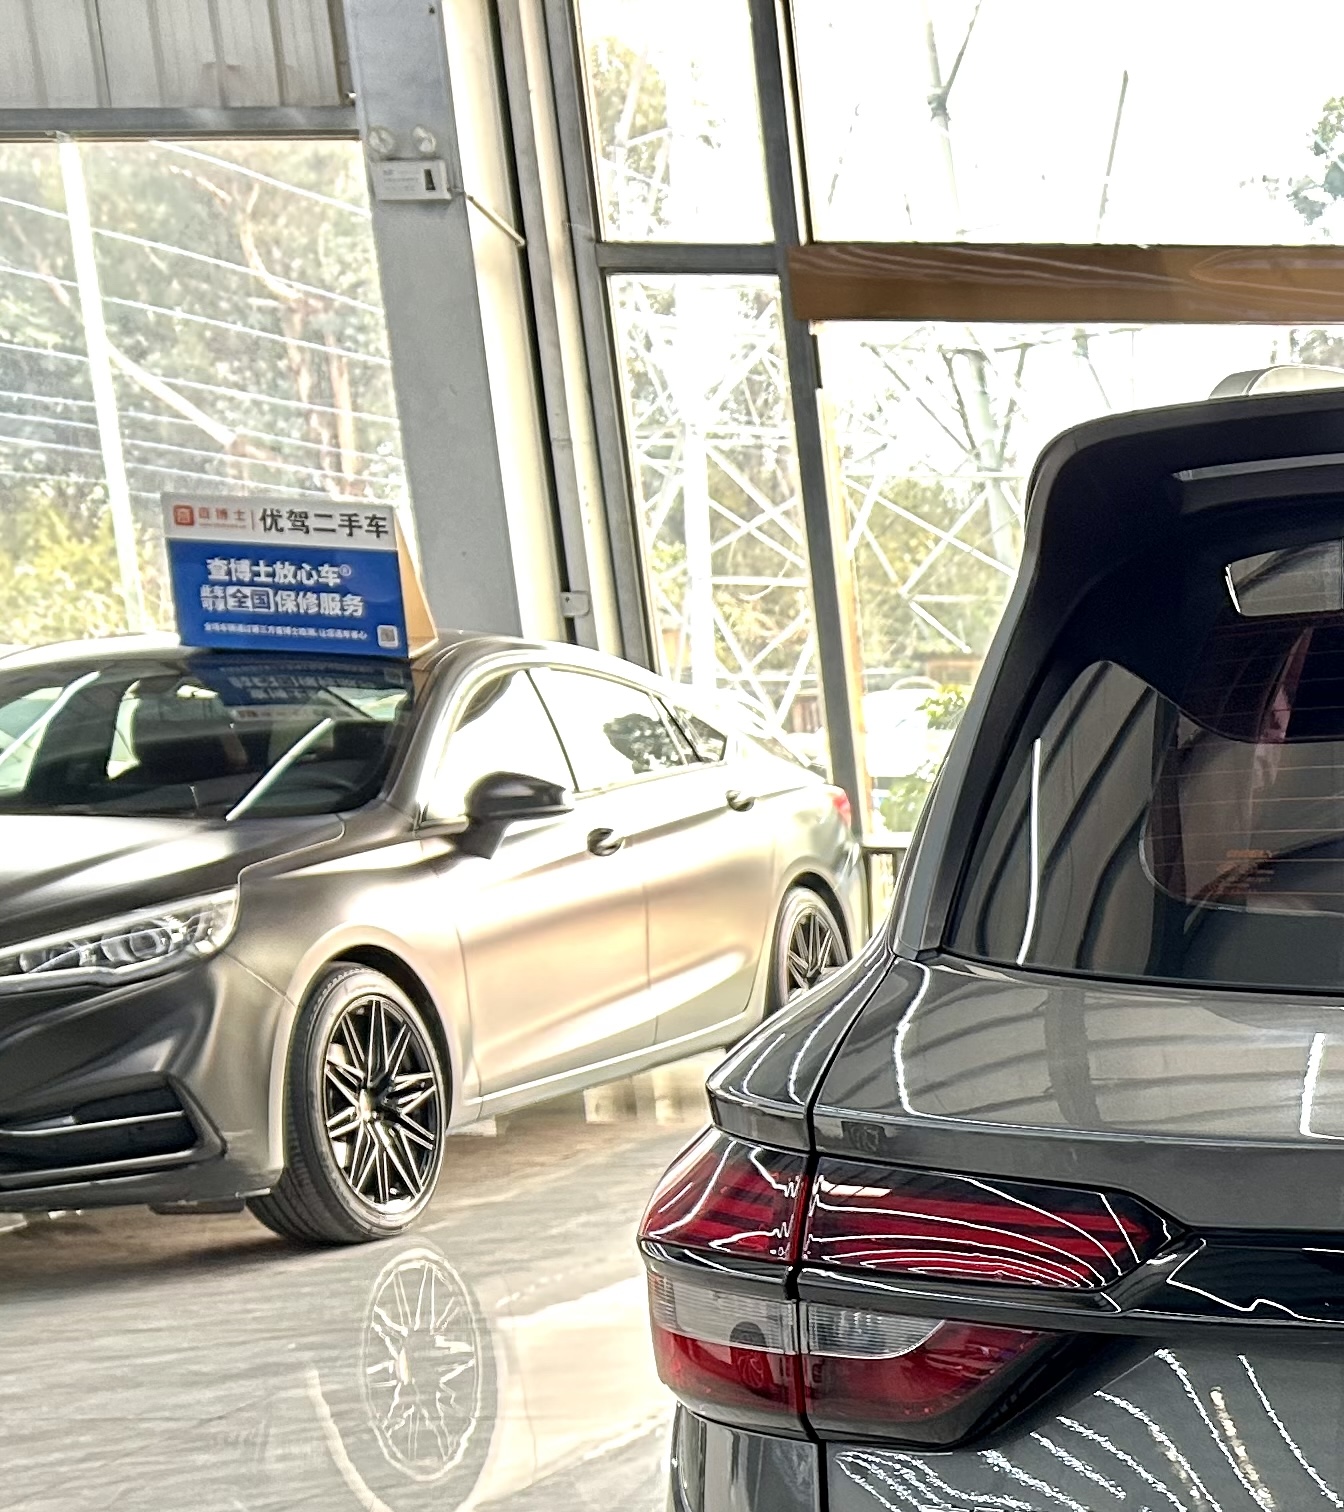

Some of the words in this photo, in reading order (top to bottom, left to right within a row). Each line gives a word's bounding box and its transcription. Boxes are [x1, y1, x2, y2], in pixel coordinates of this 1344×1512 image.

[259, 508, 389, 538] 优驾二手车
